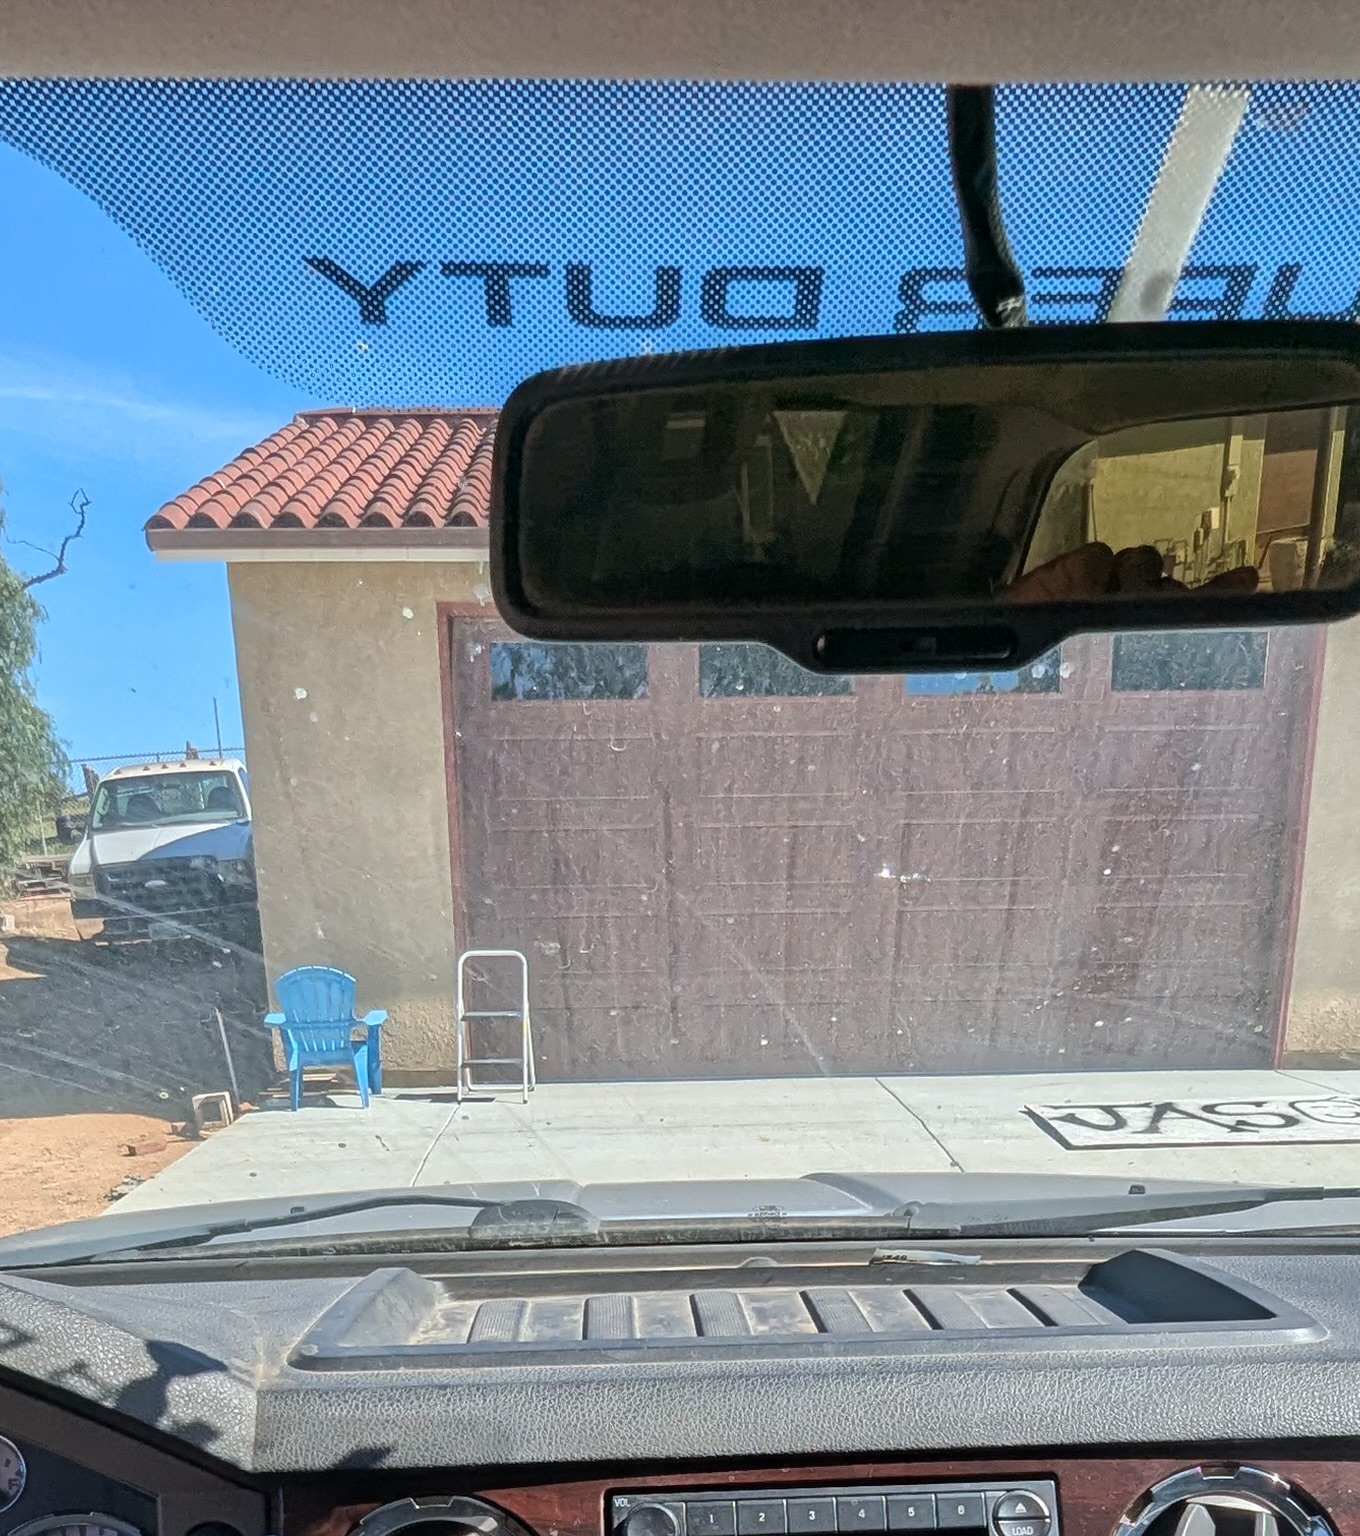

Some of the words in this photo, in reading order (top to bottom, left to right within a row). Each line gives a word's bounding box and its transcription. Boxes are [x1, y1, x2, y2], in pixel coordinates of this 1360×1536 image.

[615, 1498, 631, 1507] VOL
[758, 1512, 766, 1522] 2
[808, 1510, 816, 1521] 3
[858, 1509, 866, 1519] 4
[908, 1507, 916, 1517] 5
[957, 1504, 965, 1515] 6
[1012, 1527, 1034, 1536] LOAD
